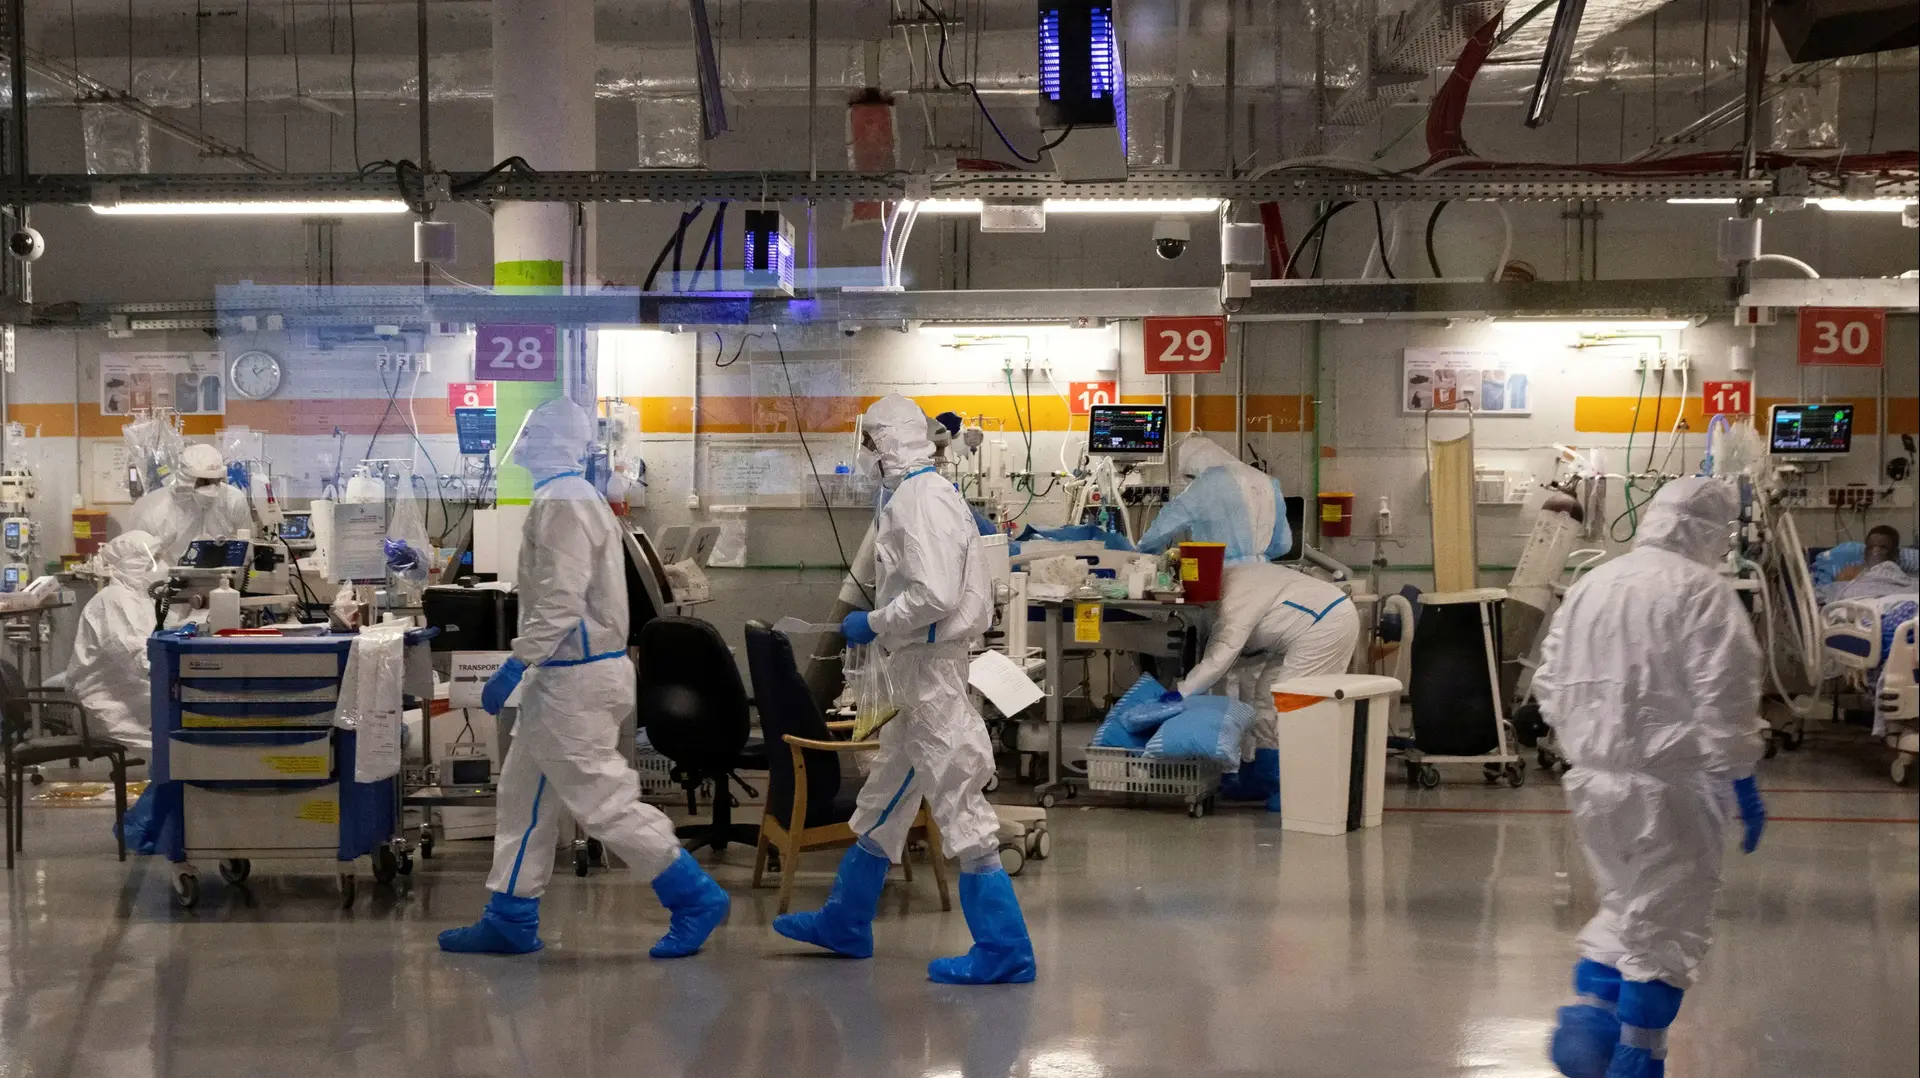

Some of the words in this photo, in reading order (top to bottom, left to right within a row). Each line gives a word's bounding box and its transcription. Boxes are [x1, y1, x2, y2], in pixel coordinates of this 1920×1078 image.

[1159, 329, 1212, 361] 29
[1813, 321, 1869, 354] 30
[489, 336, 543, 369] 28
[463, 391, 479, 407] 9
[1078, 390, 1109, 411] 10
[1712, 390, 1741, 411] 11
